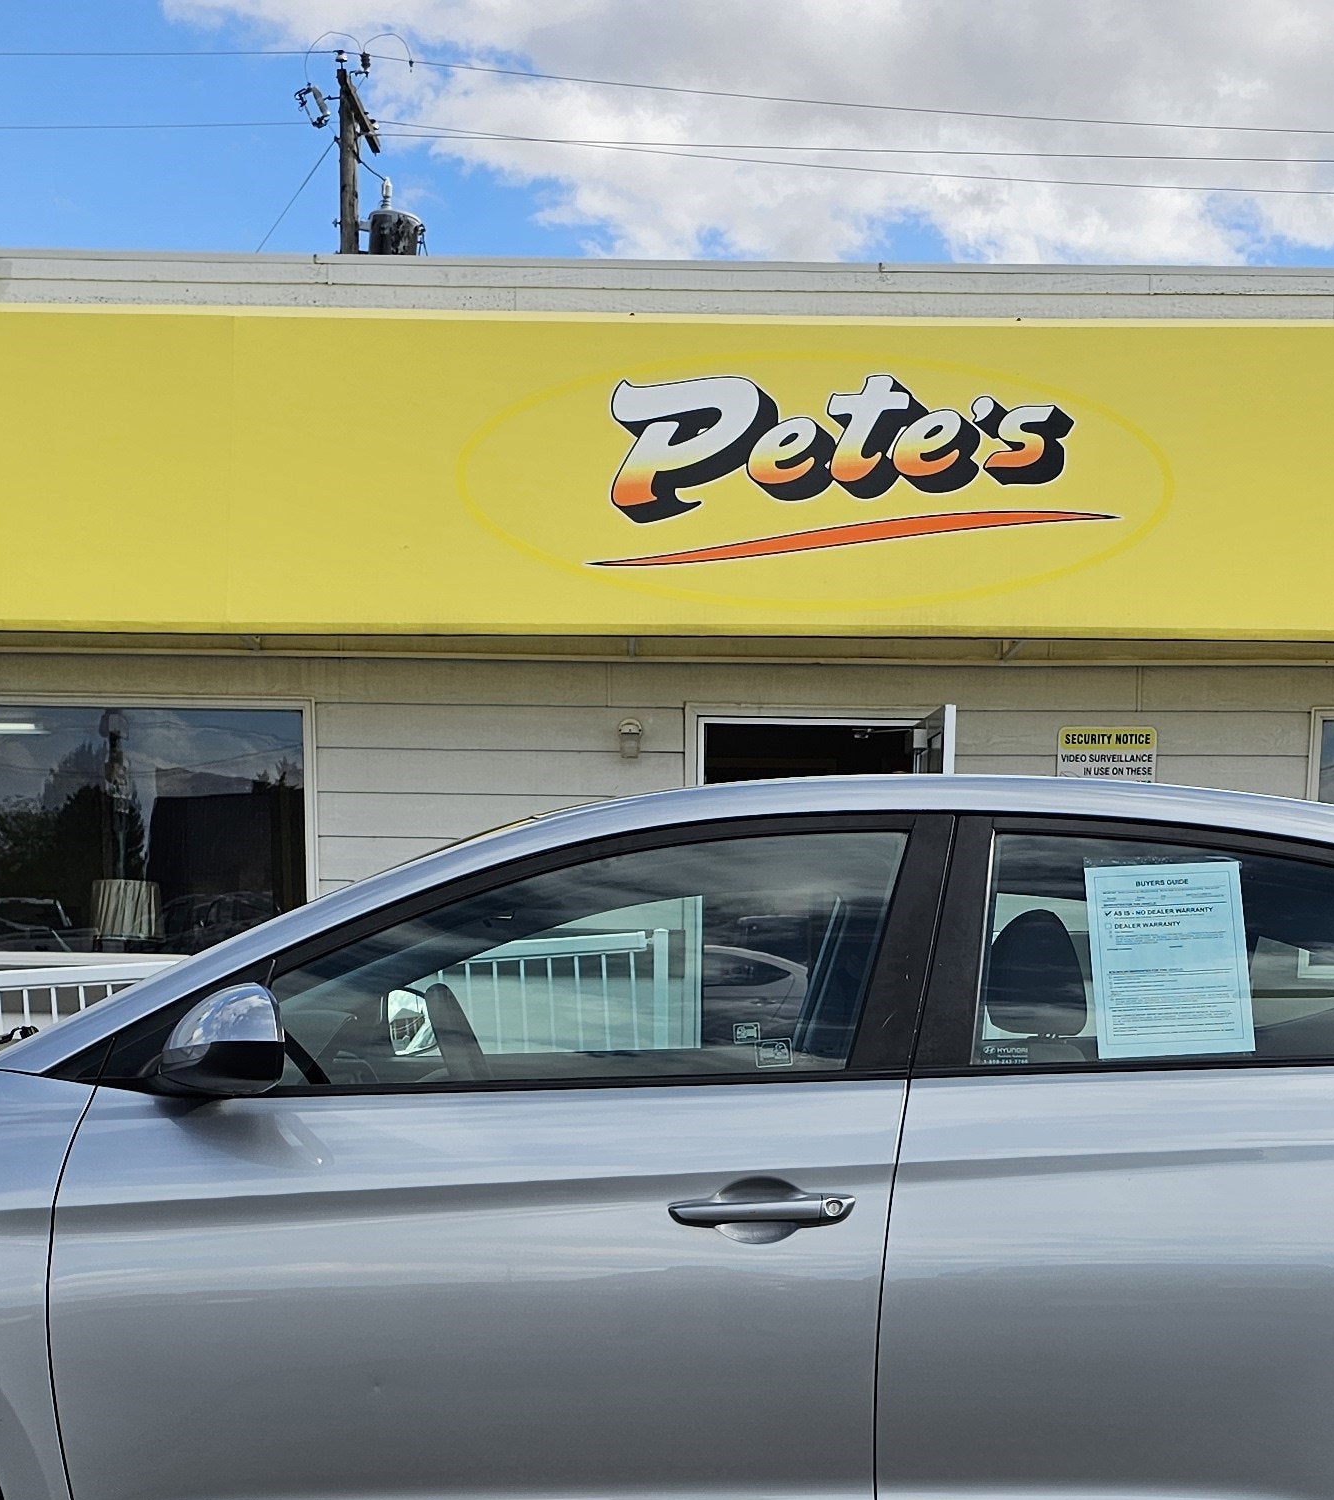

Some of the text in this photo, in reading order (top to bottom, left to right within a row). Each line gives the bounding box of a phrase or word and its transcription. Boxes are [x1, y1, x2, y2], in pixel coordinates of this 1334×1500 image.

[610, 374, 1075, 524] Pete's
[1065, 734, 1151, 744] SECURITY NOTICE
[1060, 754, 1153, 763] VIDEO SURVEILLANCE
[1083, 767, 1153, 776] IN USE ON THESE
[1135, 878, 1189, 887] BUYERS GUIDE
[1147, 908, 1174, 916] DEALER
[1175, 906, 1214, 914] WARRANTY
[1114, 920, 1181, 930] DEALER WARRANTY
